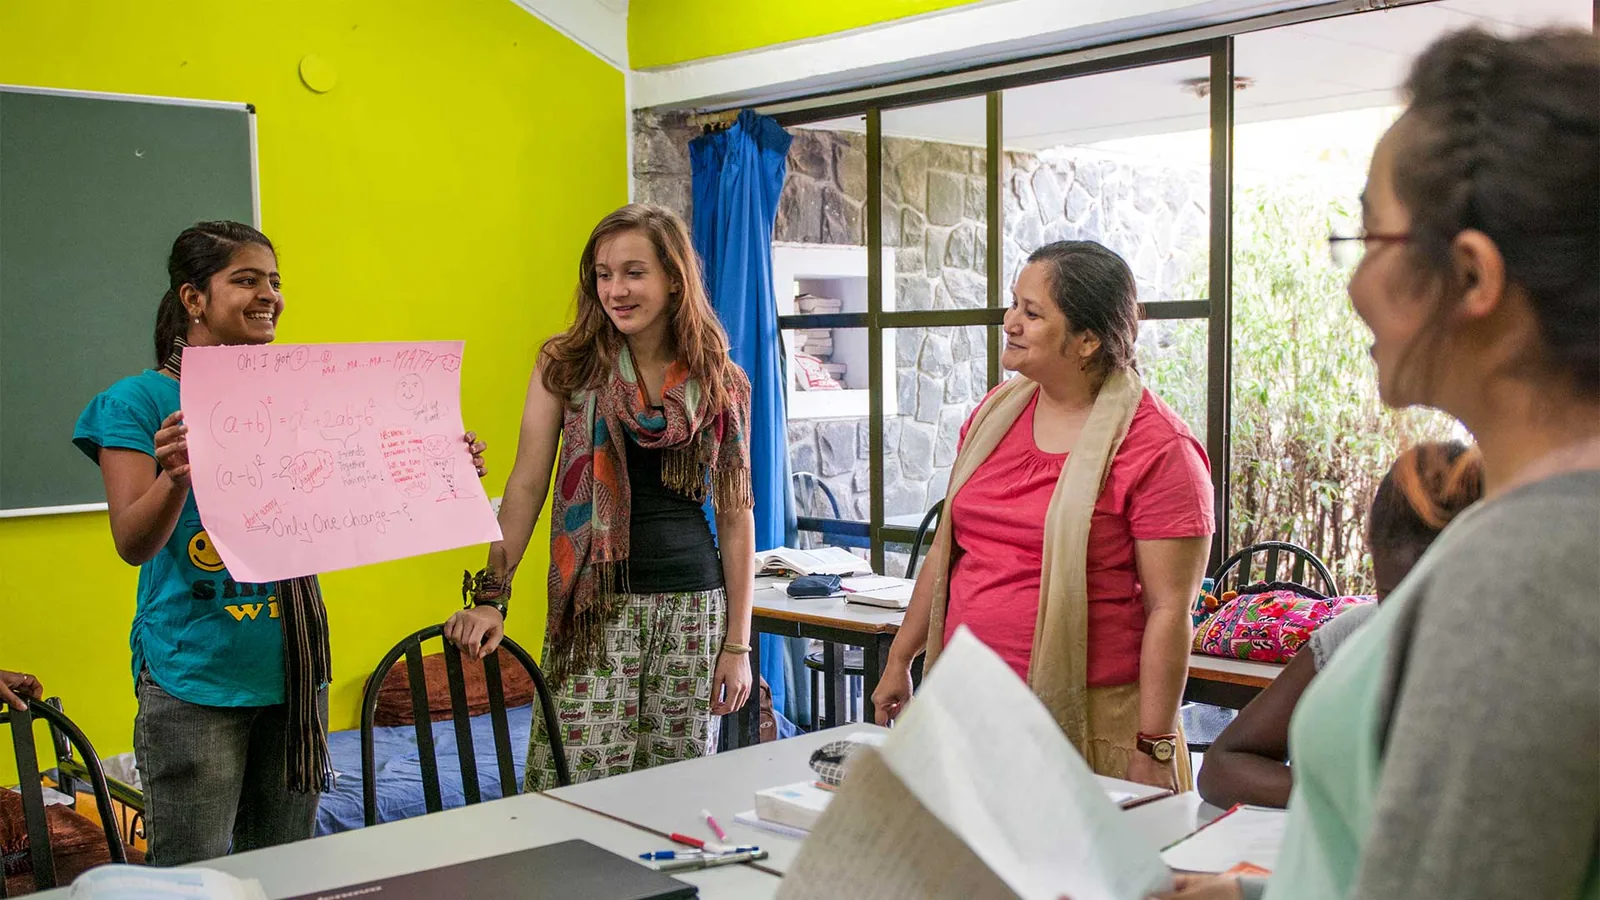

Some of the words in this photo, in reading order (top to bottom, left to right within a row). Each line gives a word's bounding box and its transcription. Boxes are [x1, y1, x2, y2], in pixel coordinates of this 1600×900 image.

[237, 352, 257, 371] Oh!
[260, 352, 269, 368] I
[273, 352, 291, 372] got
[272, 515, 313, 543] Only
[313, 513, 341, 533] One
[343, 508, 391, 535] change
[224, 595, 280, 622] wi
